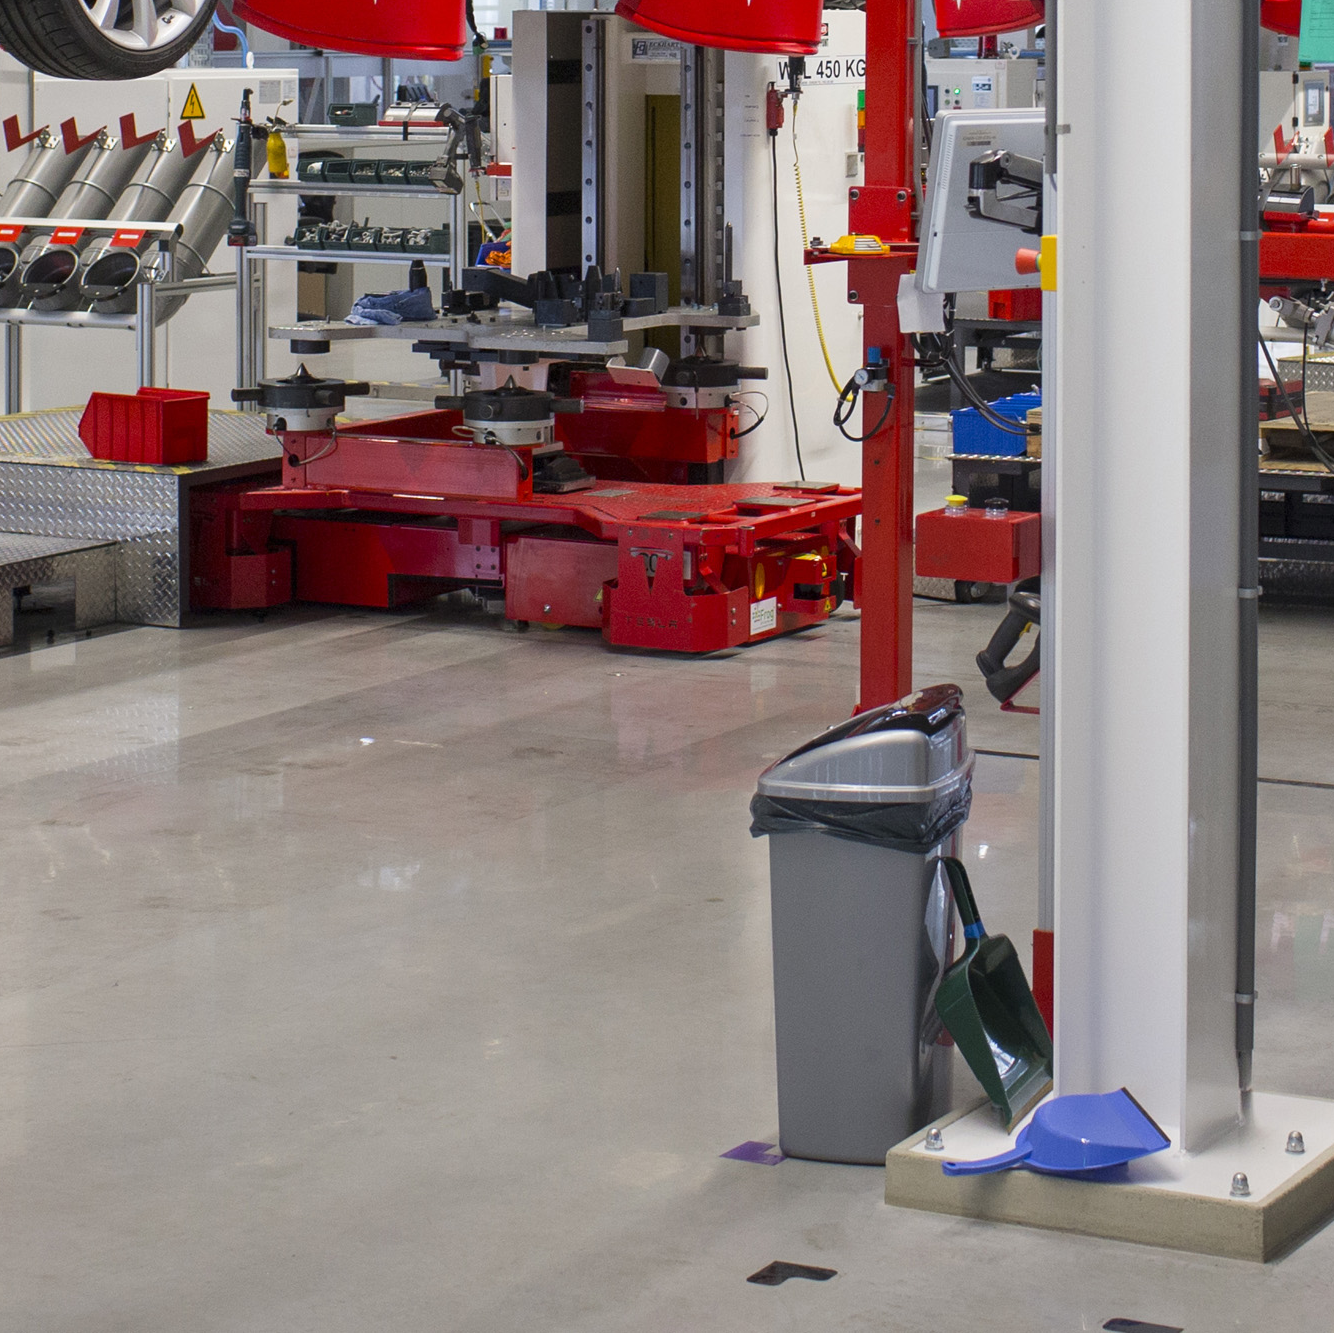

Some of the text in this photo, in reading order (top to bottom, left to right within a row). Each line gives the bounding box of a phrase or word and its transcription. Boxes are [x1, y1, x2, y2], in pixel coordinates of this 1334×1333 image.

[779, 59, 866, 80] WL 450 KG
[625, 617, 678, 628] TESLA
